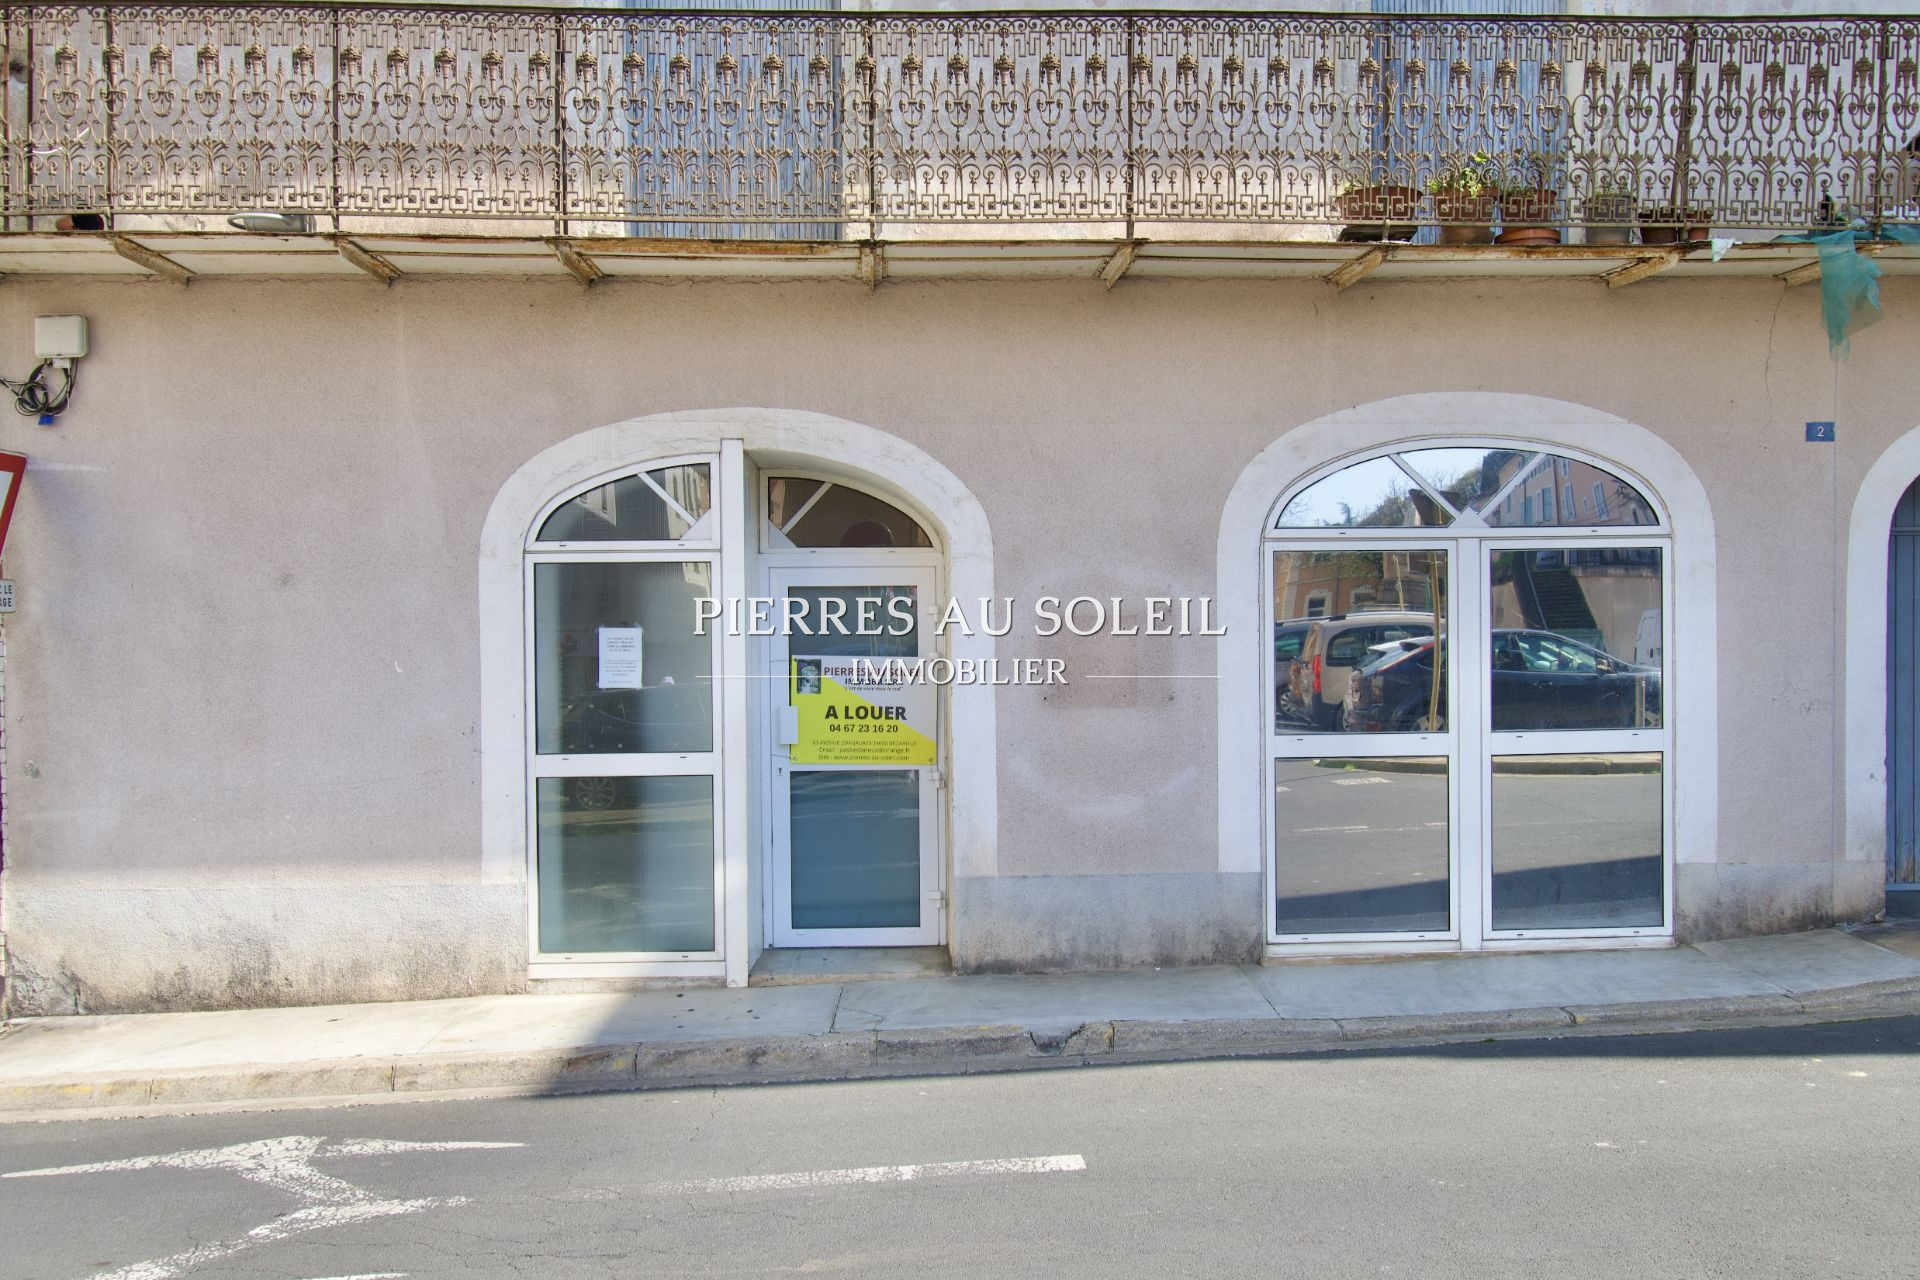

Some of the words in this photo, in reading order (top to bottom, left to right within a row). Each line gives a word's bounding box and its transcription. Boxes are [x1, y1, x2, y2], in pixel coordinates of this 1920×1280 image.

[1816, 426, 1825, 437] 2
[4, 585, 12, 594] LE
[825, 705, 839, 720] A
[845, 705, 907, 721] LOUER
[829, 724, 841, 733] 04
[844, 724, 855, 733] 67
[858, 724, 870, 733] 23
[873, 724, 884, 733] 16
[887, 724, 899, 733] 20
